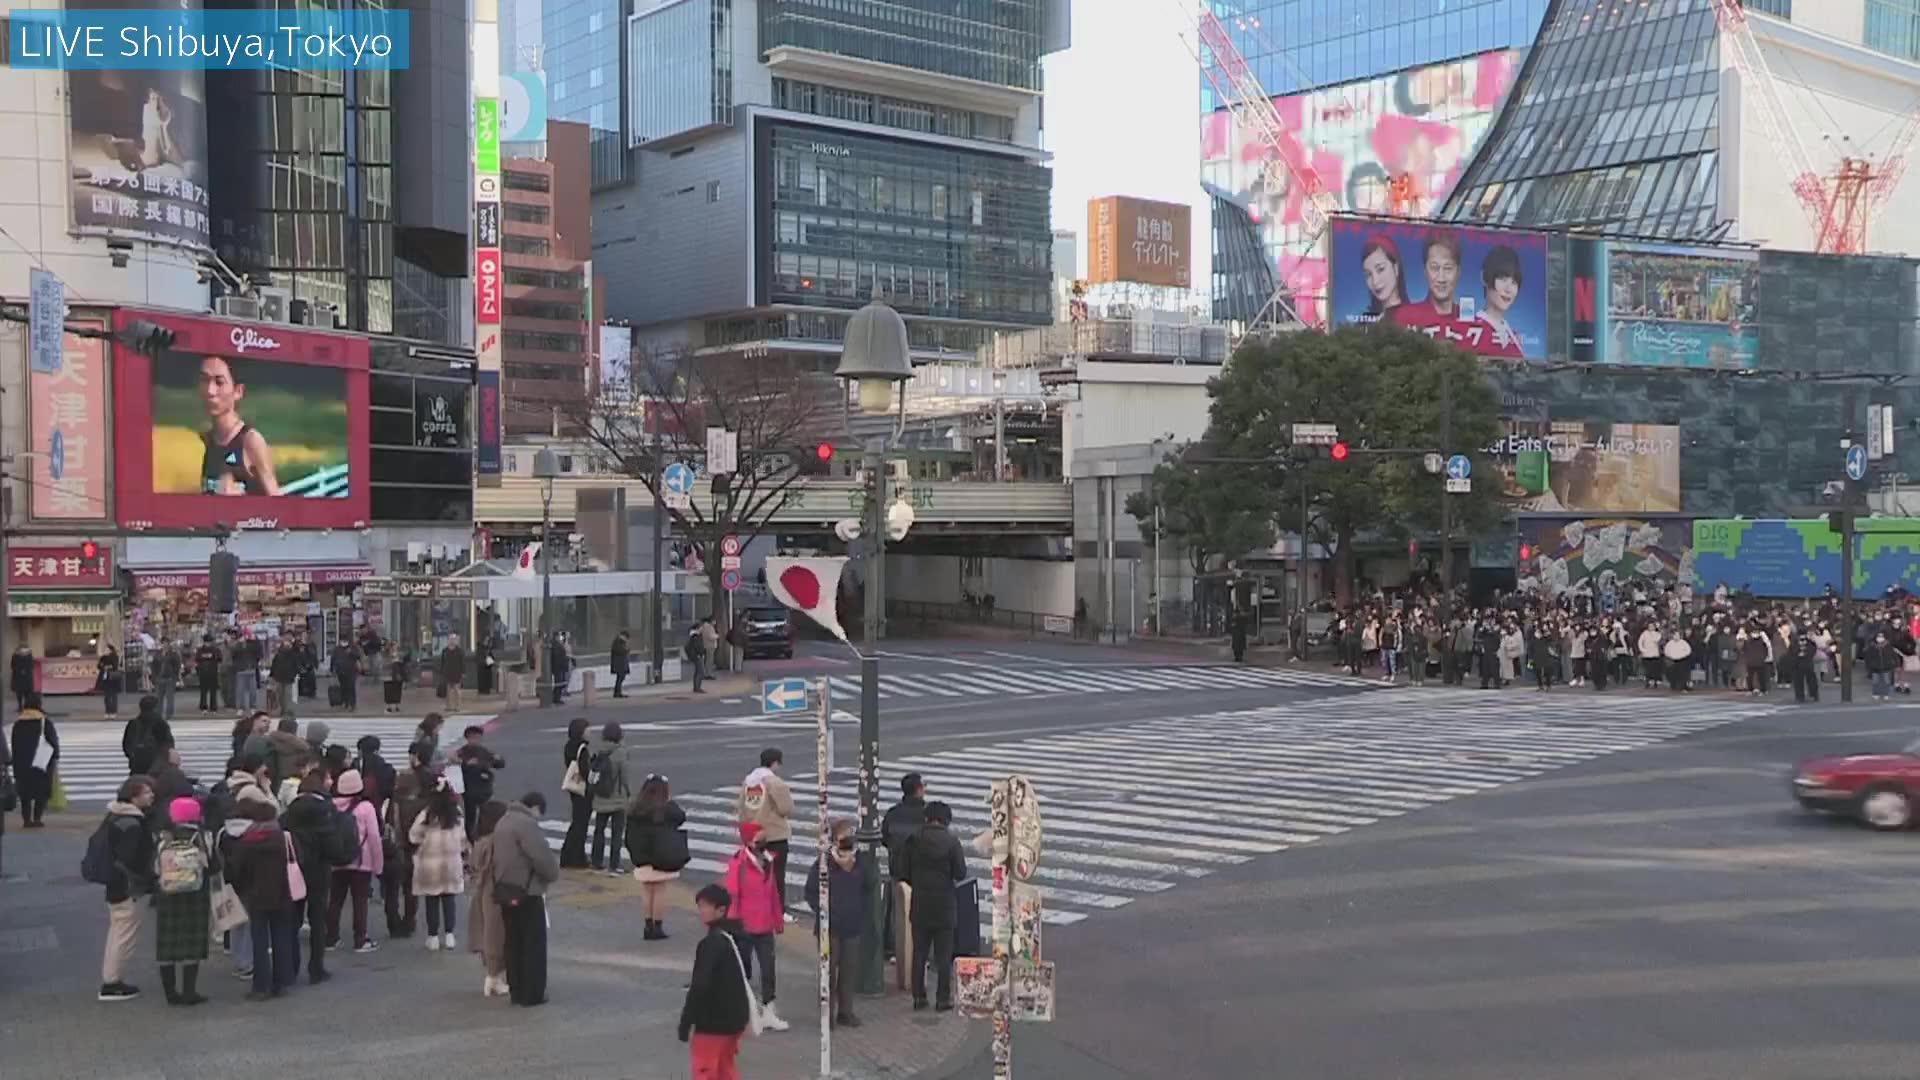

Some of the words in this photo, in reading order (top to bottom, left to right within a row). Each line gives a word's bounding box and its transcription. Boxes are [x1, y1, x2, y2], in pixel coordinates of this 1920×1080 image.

[230, 327, 281, 352] Glico
[1508, 434, 1542, 453] Eats
[13, 556, 105, 577] 天津甘
